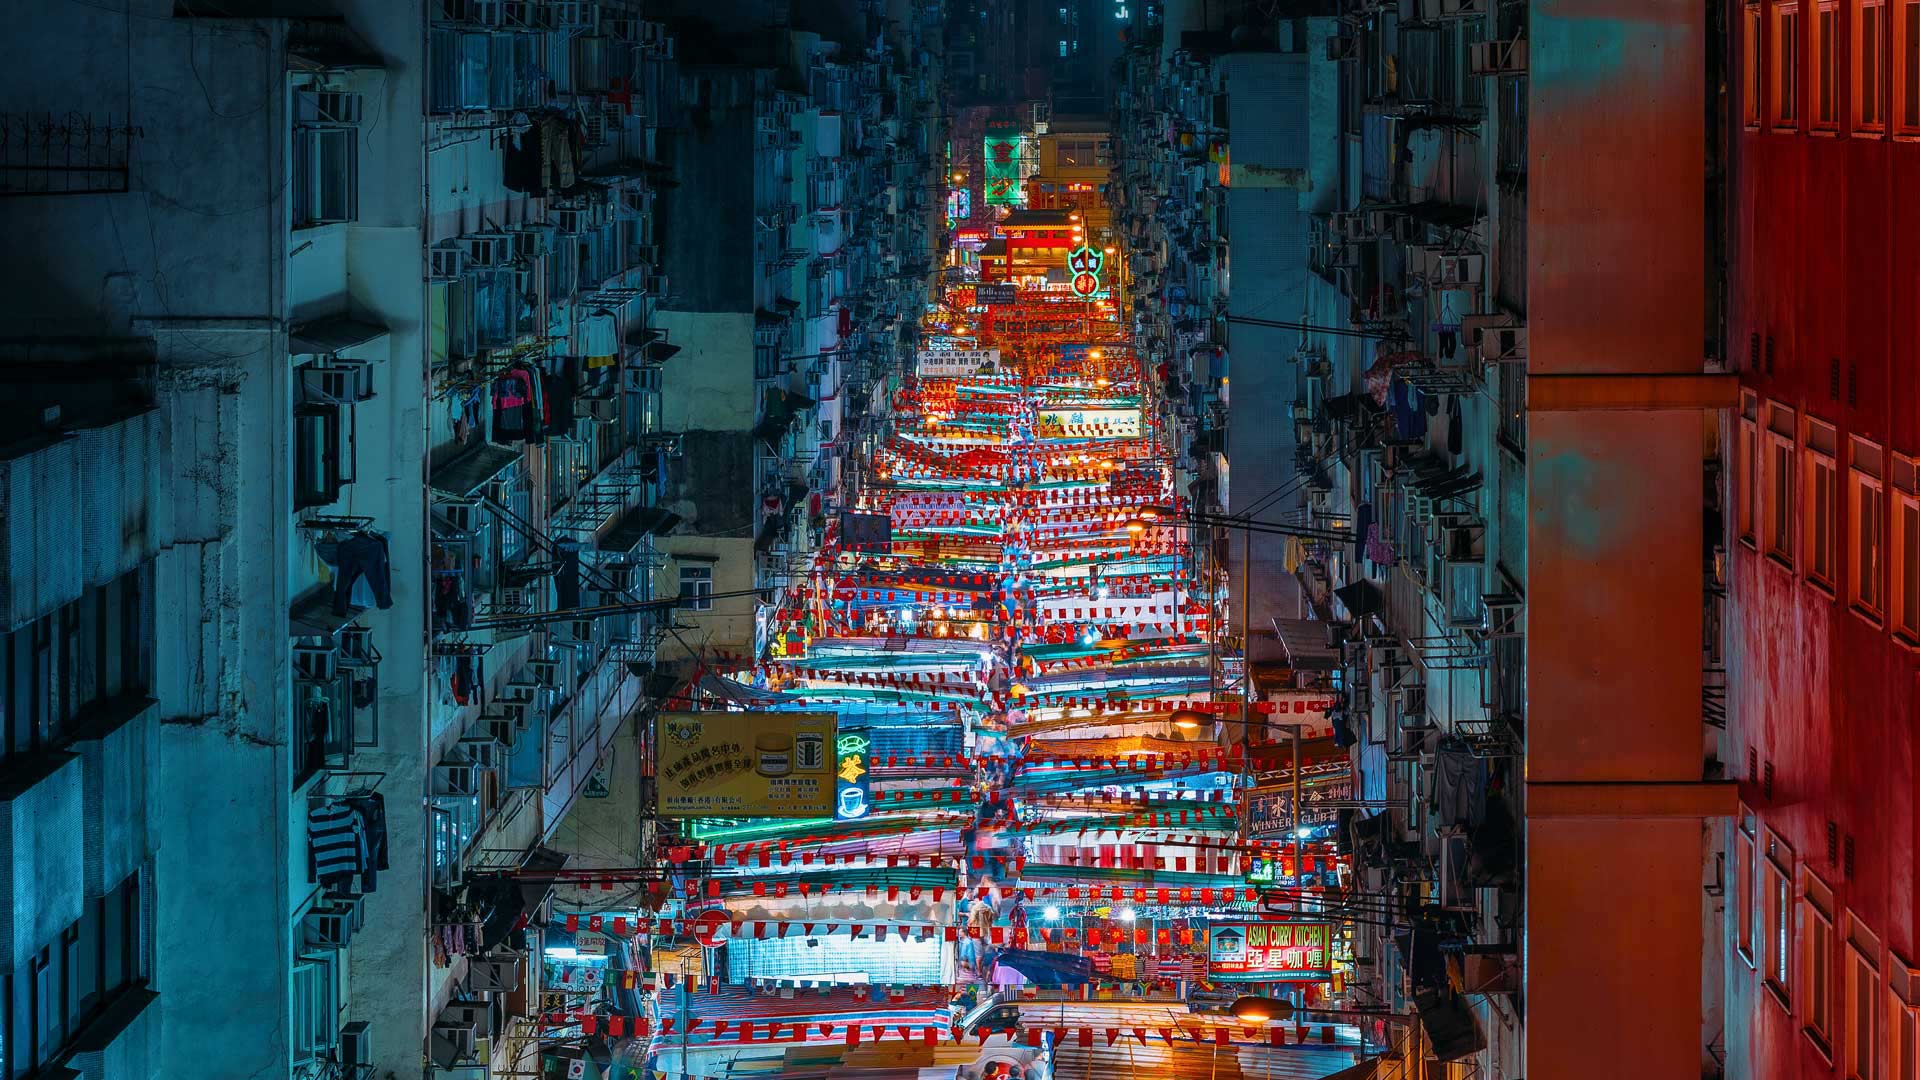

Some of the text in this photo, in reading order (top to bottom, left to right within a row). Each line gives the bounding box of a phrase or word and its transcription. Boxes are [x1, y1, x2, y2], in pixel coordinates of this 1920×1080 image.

[1247, 926, 1323, 947] ASIAN CURRY KITCHEN
